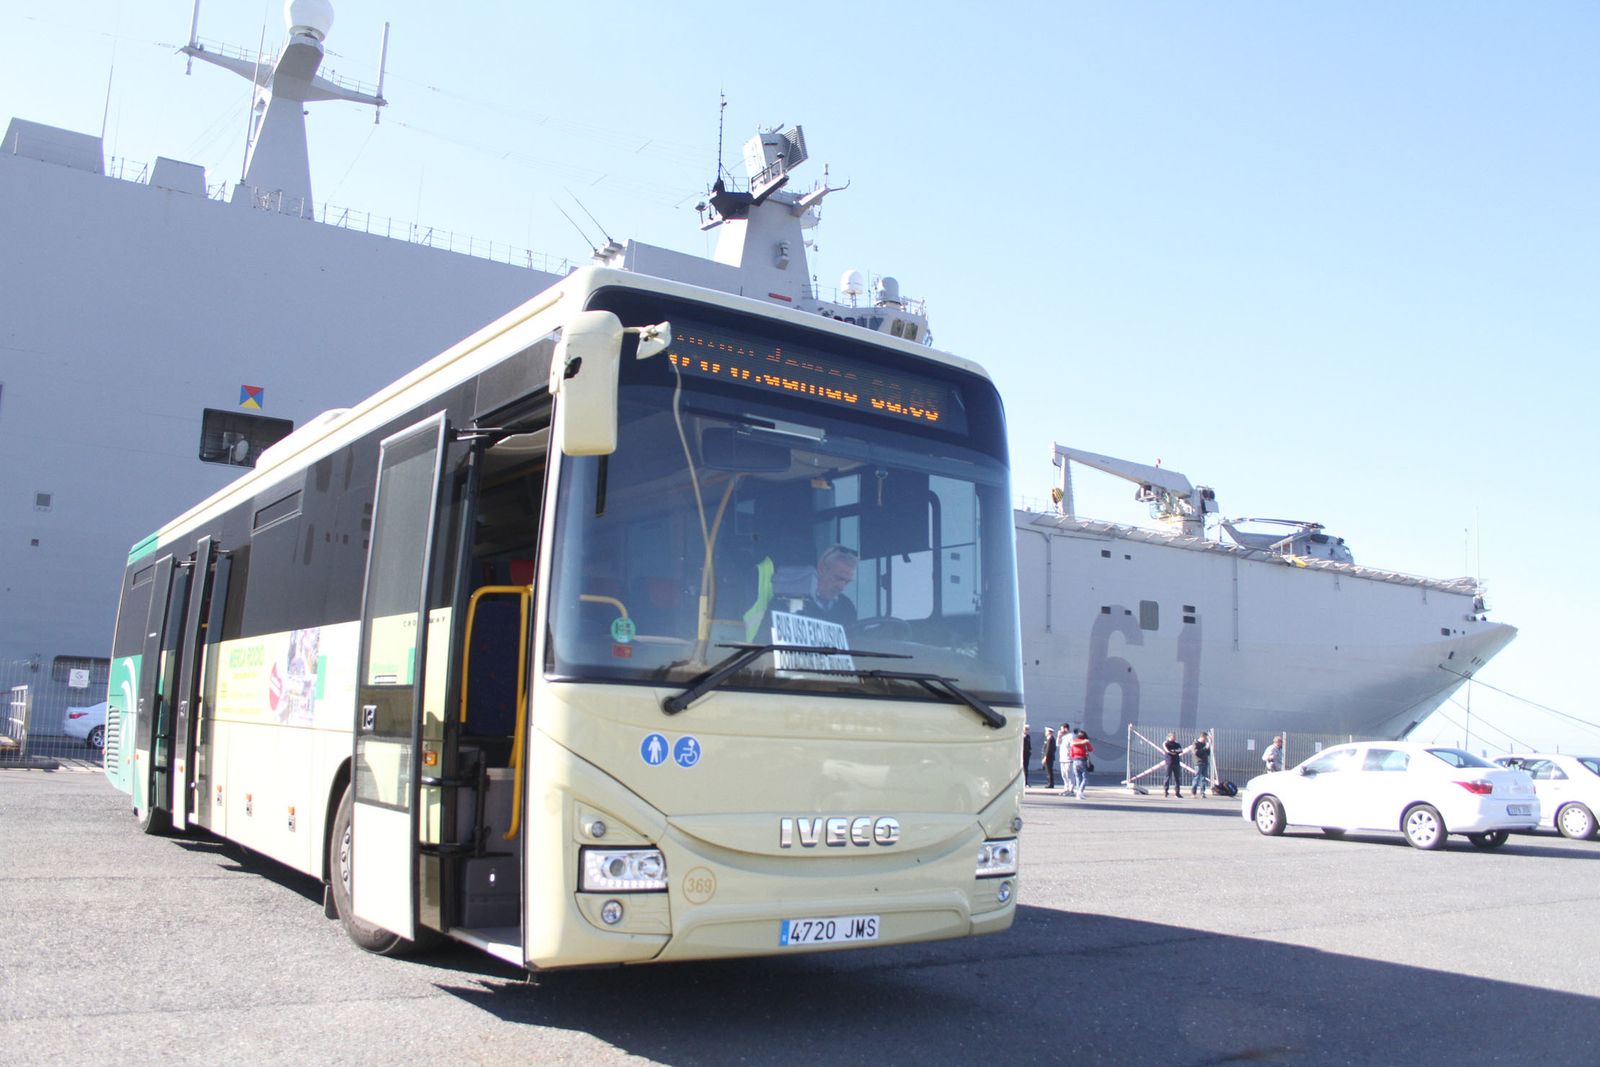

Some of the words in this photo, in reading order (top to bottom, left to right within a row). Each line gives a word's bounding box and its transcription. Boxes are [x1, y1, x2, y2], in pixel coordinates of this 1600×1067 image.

[776, 614, 792, 643] BUS
[1083, 604, 1203, 762] 61
[780, 816, 900, 849] IVECO
[687, 877, 712, 893] 369
[791, 920, 836, 942] 4720
[845, 918, 876, 938] JMS
